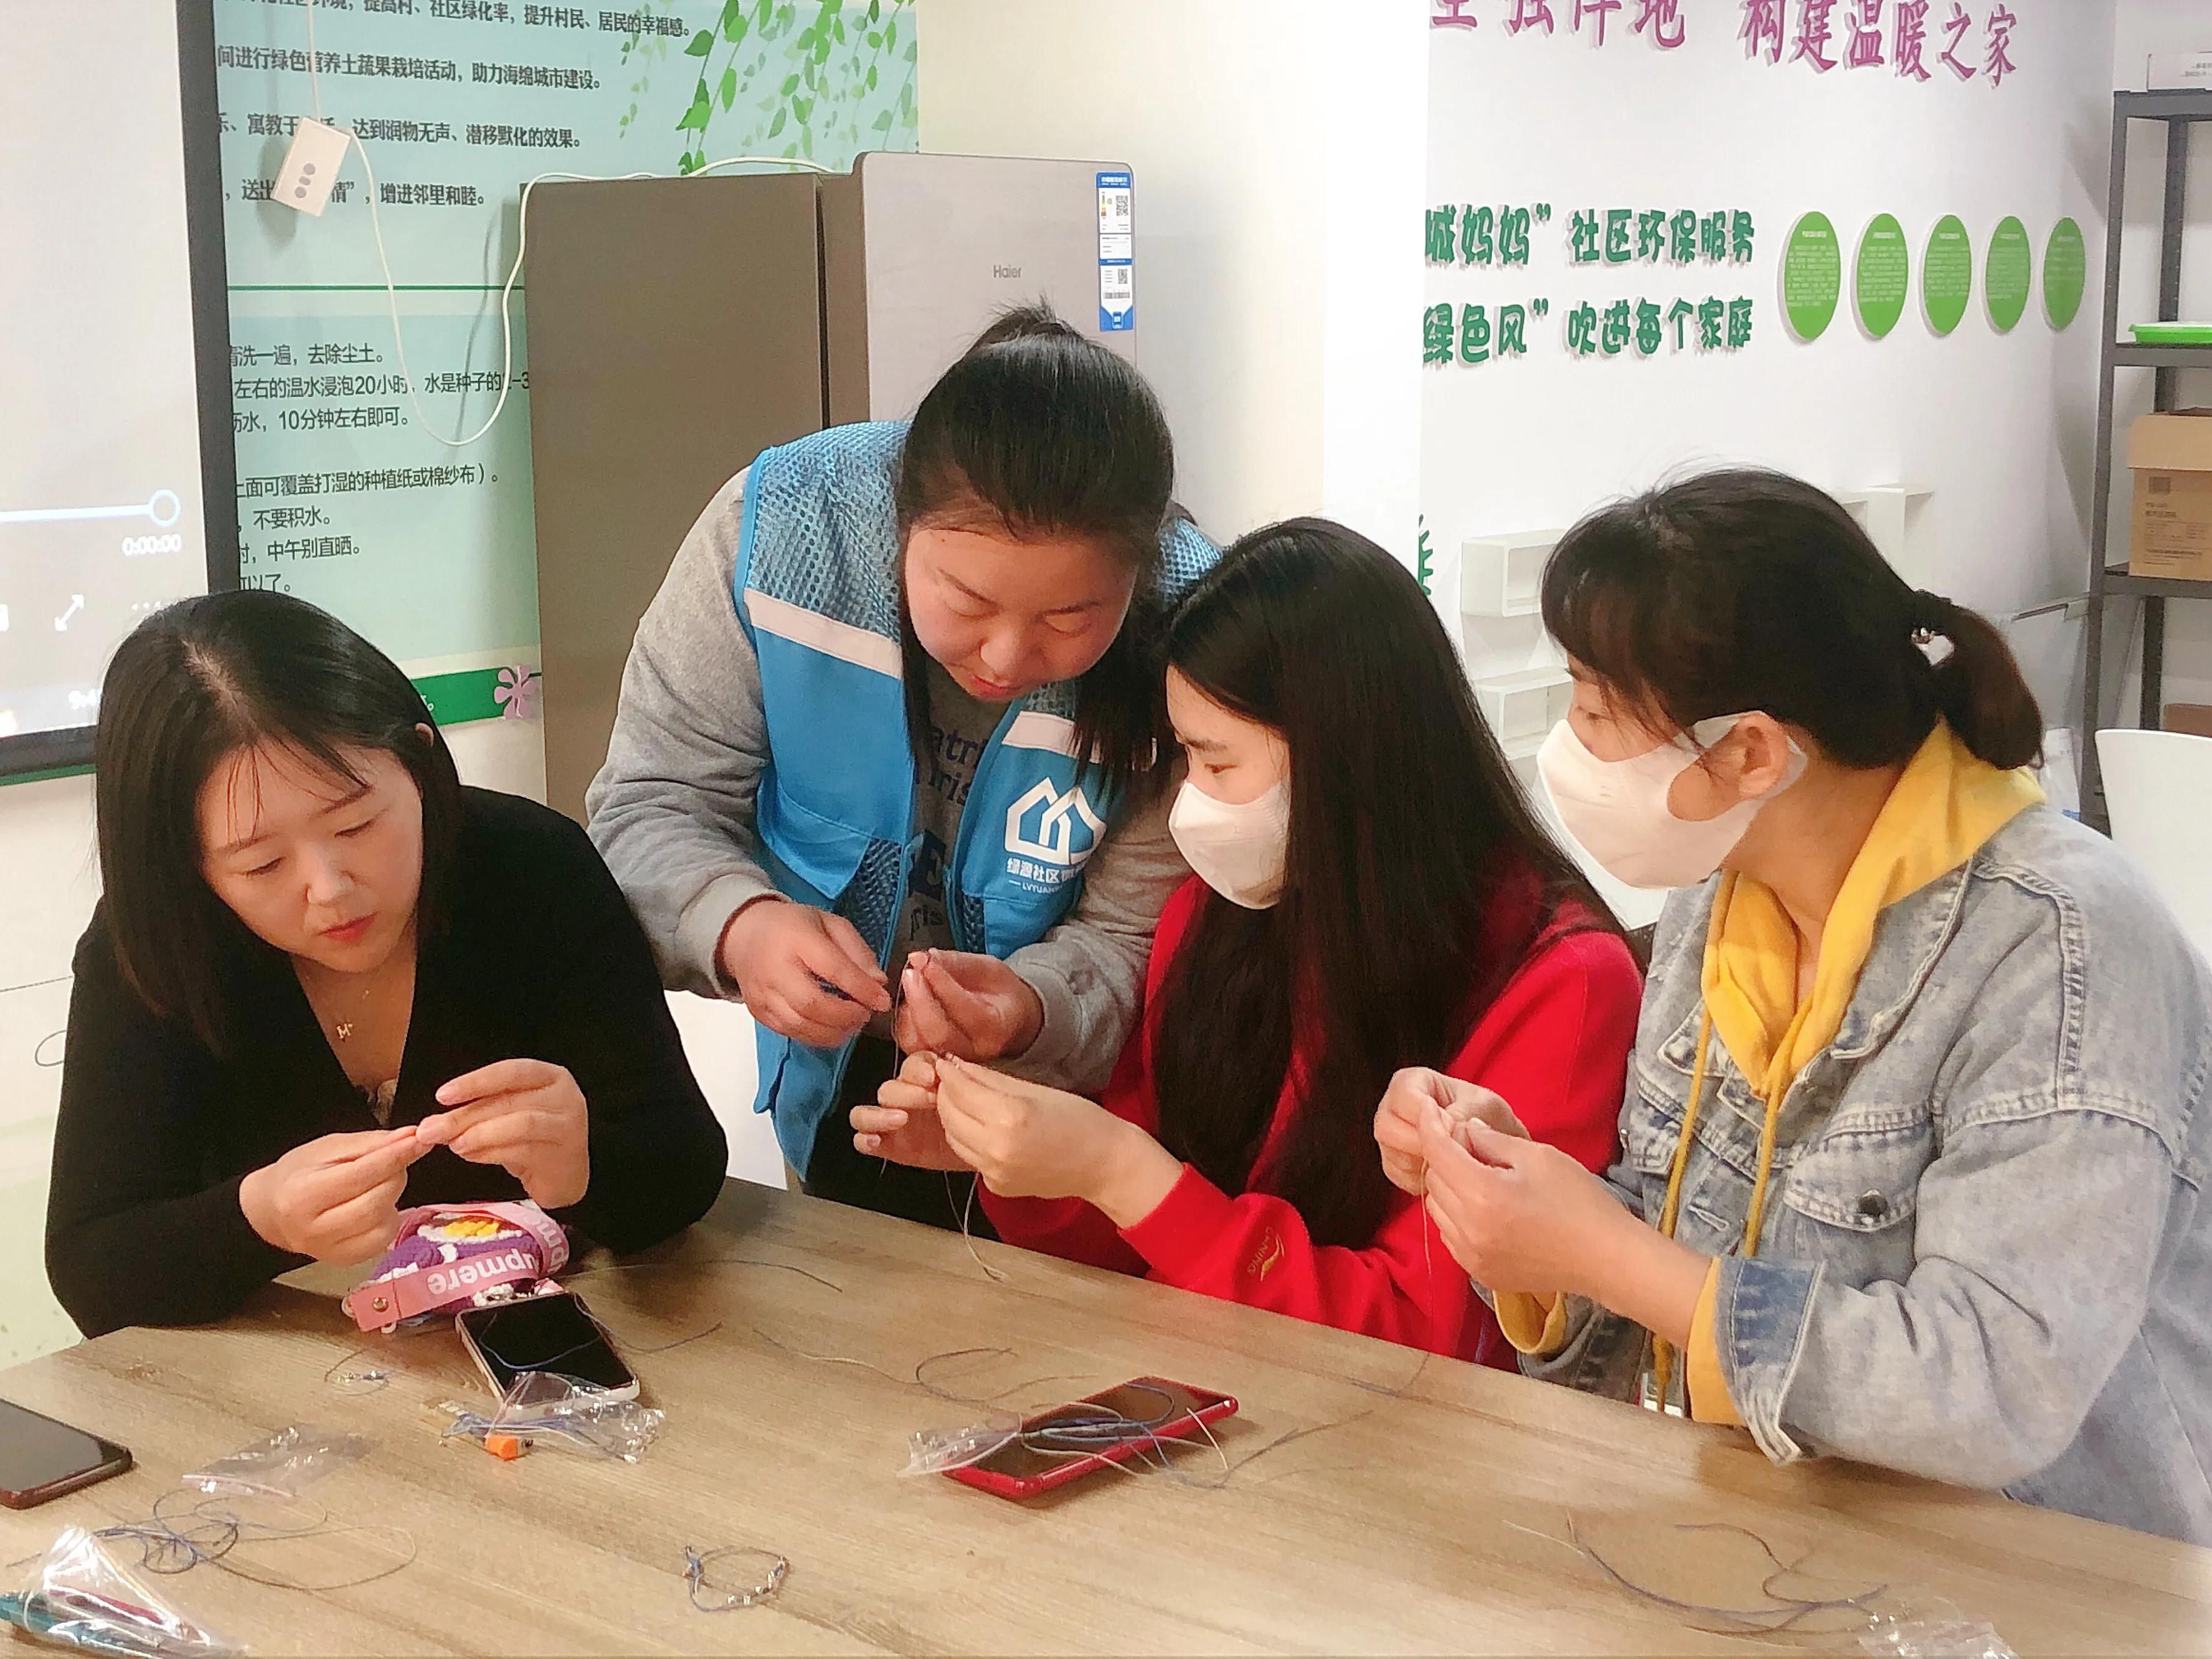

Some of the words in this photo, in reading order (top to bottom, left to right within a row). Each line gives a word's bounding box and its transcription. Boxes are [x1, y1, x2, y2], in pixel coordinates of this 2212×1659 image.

[1572, 209, 1754, 263] 社区环保服务
[993, 264, 1022, 278] Haier
[1568, 295, 1753, 355] 吹进每个家庭
[123, 534, 181, 556] 0:00:00
